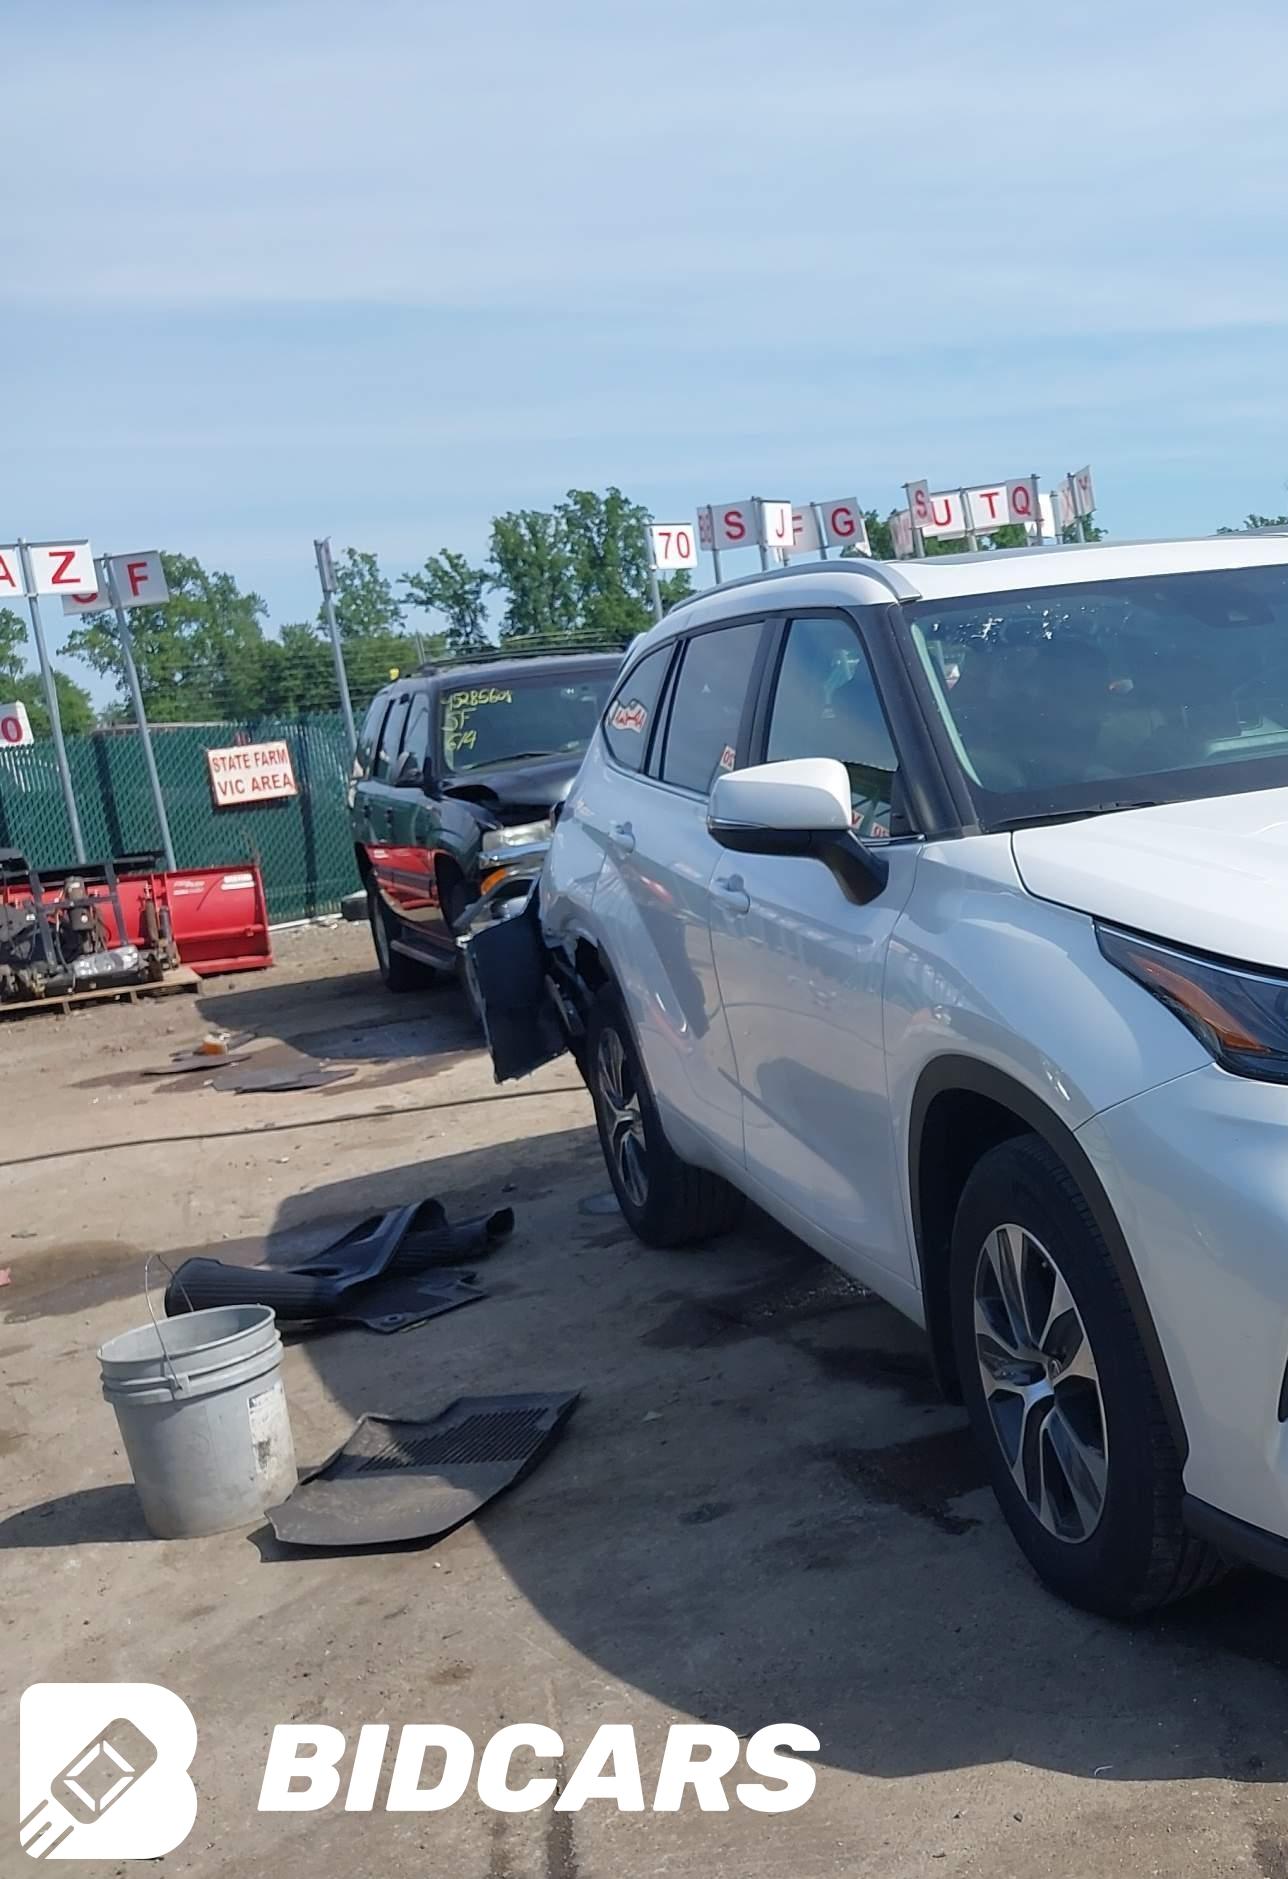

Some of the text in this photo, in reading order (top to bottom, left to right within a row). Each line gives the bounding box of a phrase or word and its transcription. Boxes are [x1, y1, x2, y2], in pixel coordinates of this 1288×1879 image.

[914, 489, 928, 519] S
[931, 491, 999, 526] U T
[1011, 486, 1031, 516] Q
[723, 510, 746, 540] S
[775, 508, 785, 538] J
[831, 507, 856, 537] G
[658, 531, 691, 560] 70
[48, 551, 81, 585] Z
[127, 561, 149, 597] F
[211, 748, 288, 773] STATE FARM
[217, 772, 294, 797] VIC AREA
